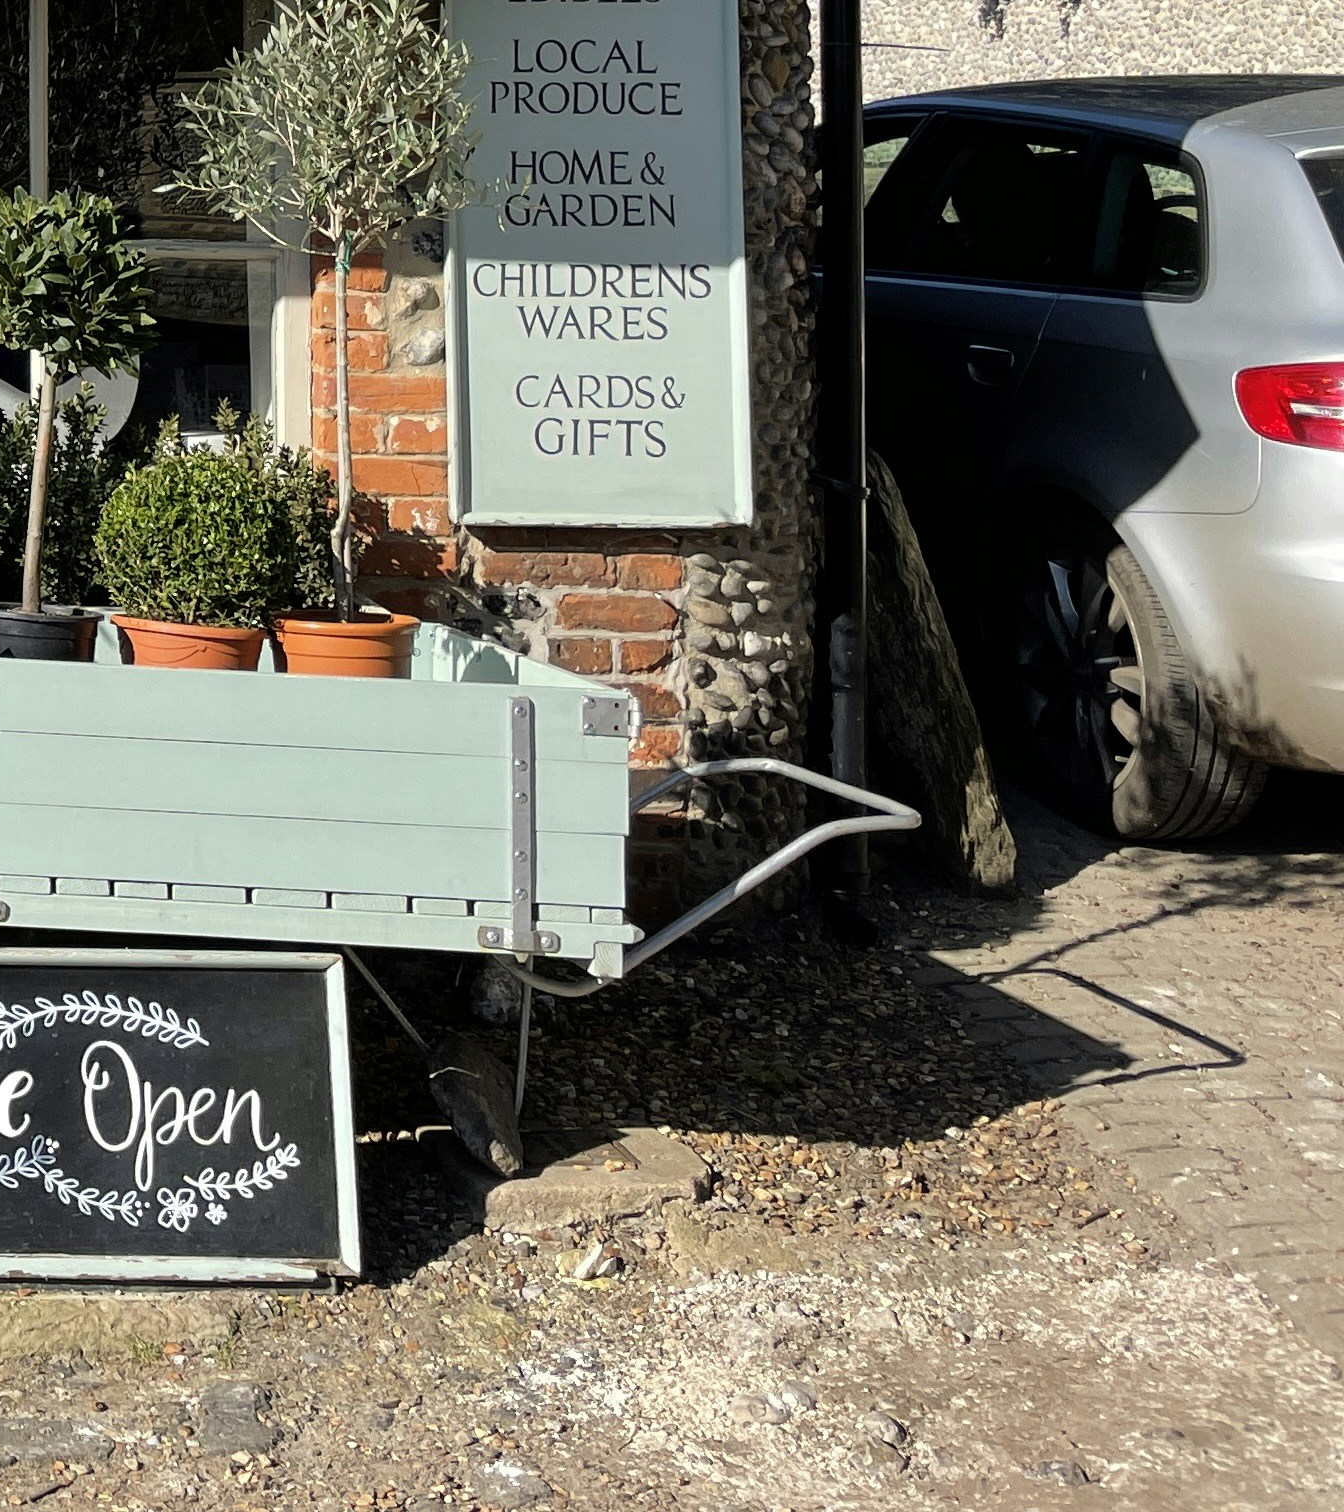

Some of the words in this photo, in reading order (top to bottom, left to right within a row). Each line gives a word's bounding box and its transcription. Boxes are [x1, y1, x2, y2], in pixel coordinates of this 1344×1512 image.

[512, 39, 658, 75] LOCAL
[489, 81, 683, 116] PRODUCE
[510, 148, 632, 186] HOME
[503, 192, 676, 228] GARDEN
[472, 262, 712, 300] CHILDRENS
[516, 305, 669, 341] WARES
[534, 417, 667, 458] GIFTS
[80, 1039, 281, 1192] Open
